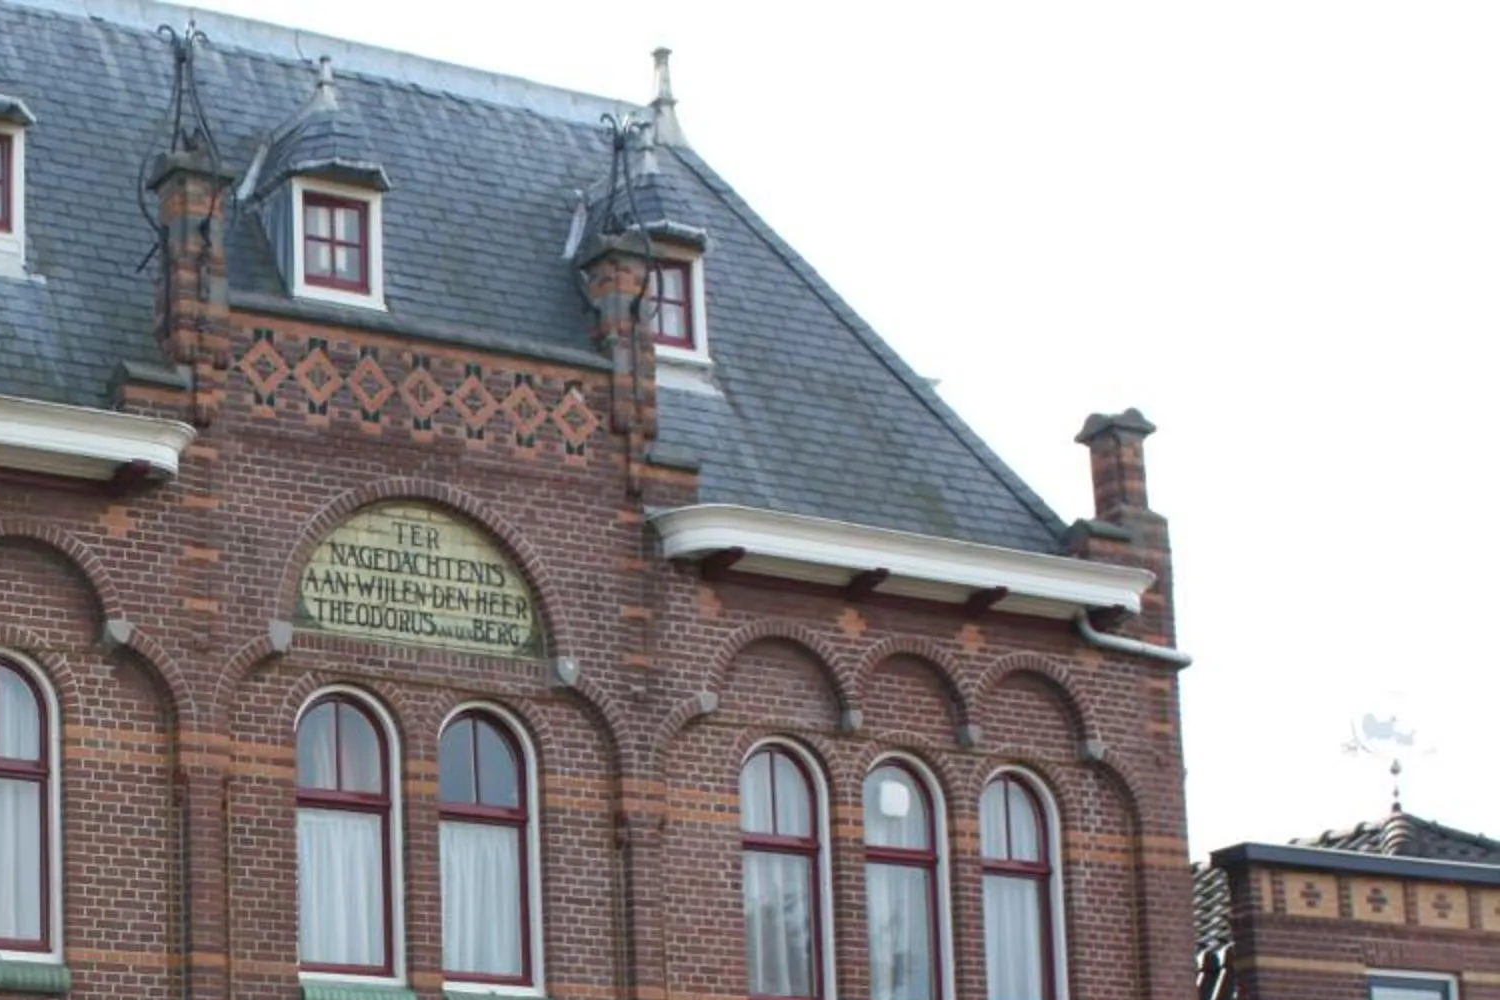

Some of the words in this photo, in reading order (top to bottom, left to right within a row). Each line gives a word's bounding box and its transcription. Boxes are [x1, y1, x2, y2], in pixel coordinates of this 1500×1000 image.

[393, 521, 439, 550] TER
[329, 541, 505, 587] NAGEDACHTENIS
[313, 597, 437, 636] THEODORUS
[472, 618, 520, 646] BERG
[475, 589, 527, 620] HEER
